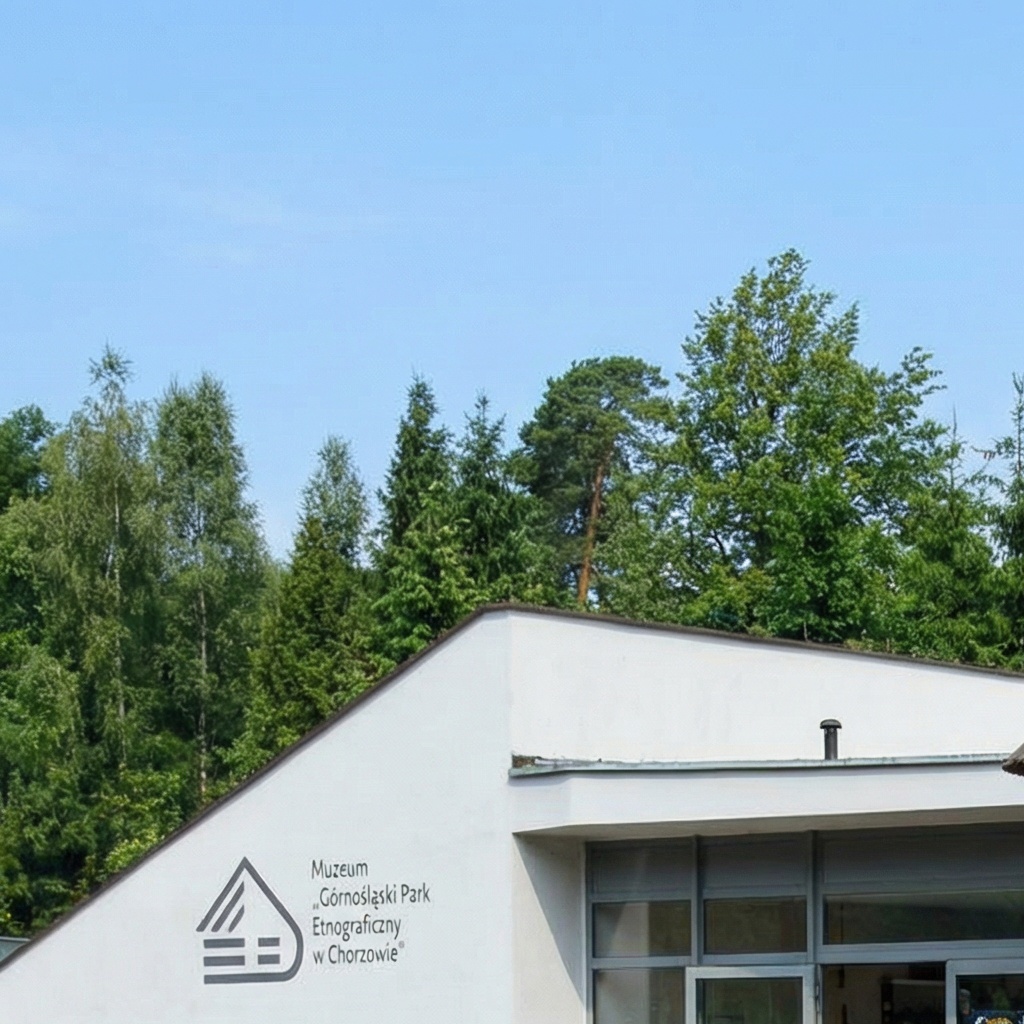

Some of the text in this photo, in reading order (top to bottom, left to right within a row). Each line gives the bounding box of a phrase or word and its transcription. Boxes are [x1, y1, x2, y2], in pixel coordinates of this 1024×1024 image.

[311, 859, 368, 879] Muzeum
[401, 882, 431, 904] Park
[312, 914, 401, 941] Etnograficzny
[313, 950, 325, 965] w
